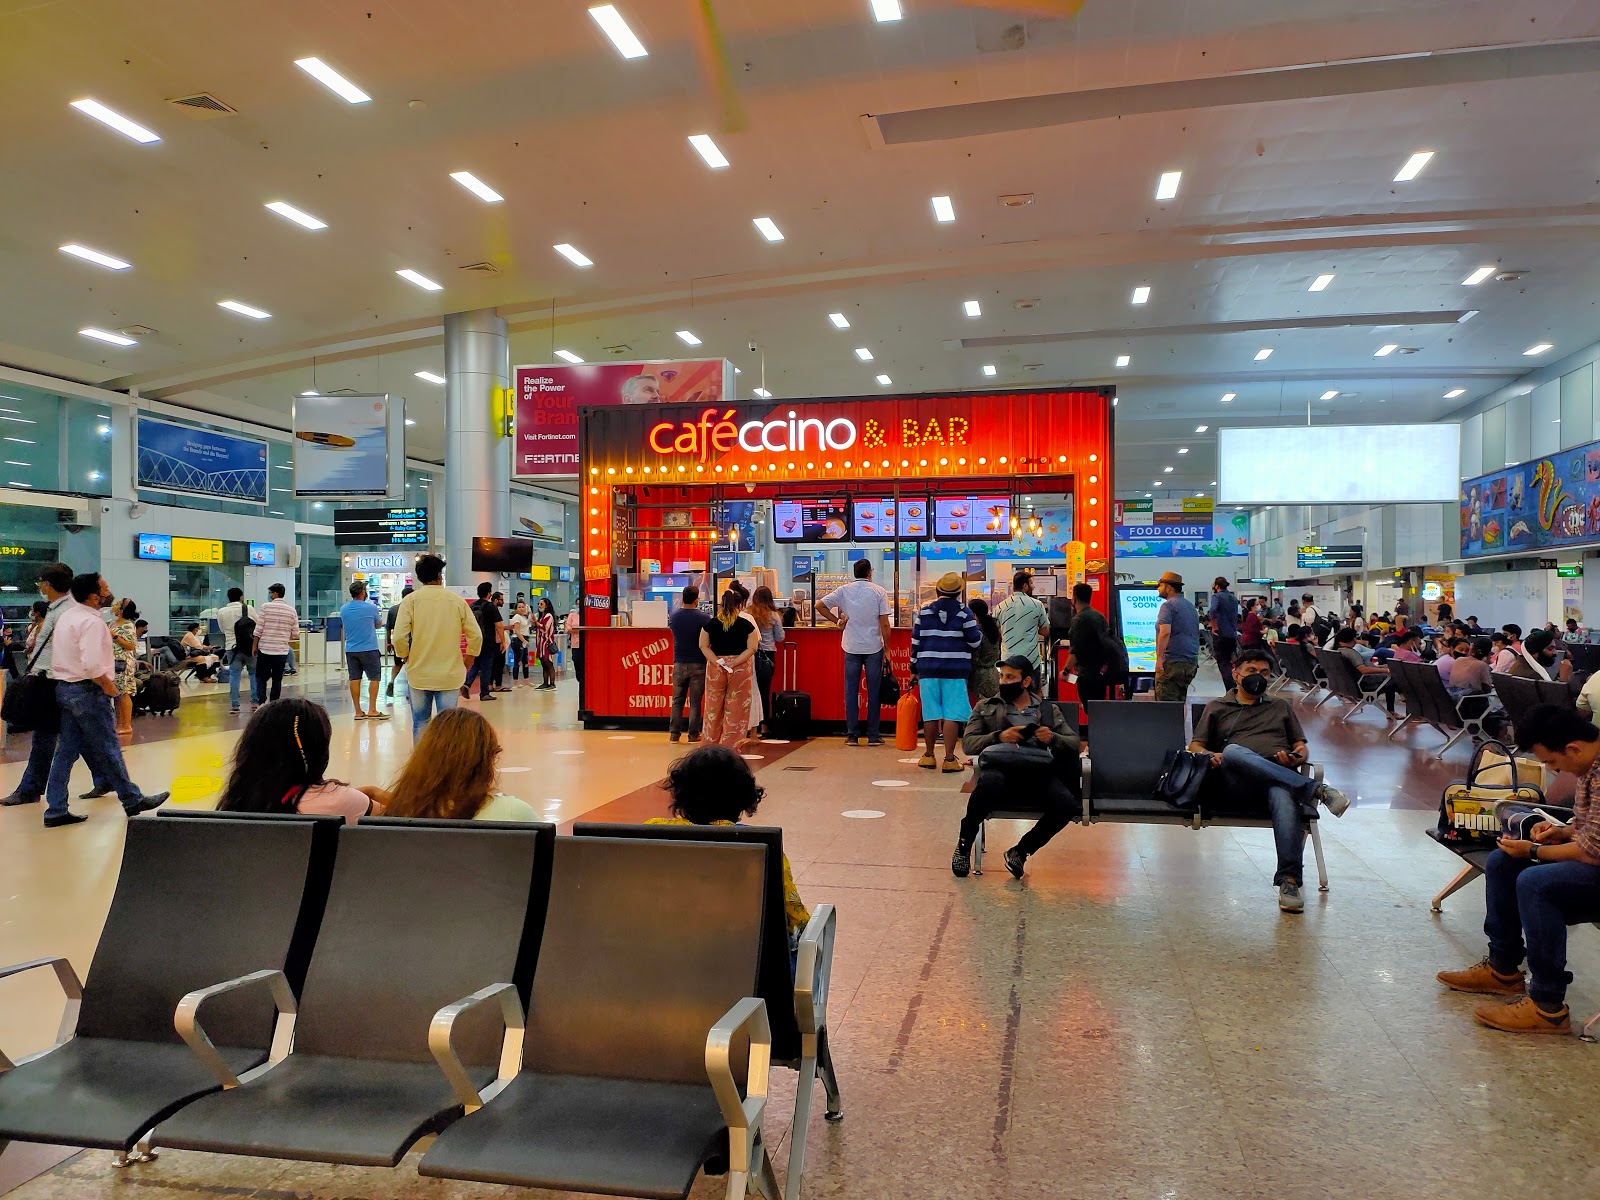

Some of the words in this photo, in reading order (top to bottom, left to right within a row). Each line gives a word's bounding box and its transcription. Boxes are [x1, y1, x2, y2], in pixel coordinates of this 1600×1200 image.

[534, 394, 575, 408] Your
[534, 410, 579, 425] Bran
[649, 409, 857, 464] caféccino
[864, 418, 887, 448] &
[903, 417, 968, 447] BAR
[524, 454, 579, 463] FORTINE
[1129, 527, 1161, 535] FOOD
[1164, 527, 1205, 535] COURT
[192, 551, 208, 560] Gate
[212, 543, 219, 560] E
[621, 651, 641, 669] ICE
[641, 638, 669, 659] COLD
[638, 664, 674, 686] BEE
[629, 695, 666, 708] SERVED
